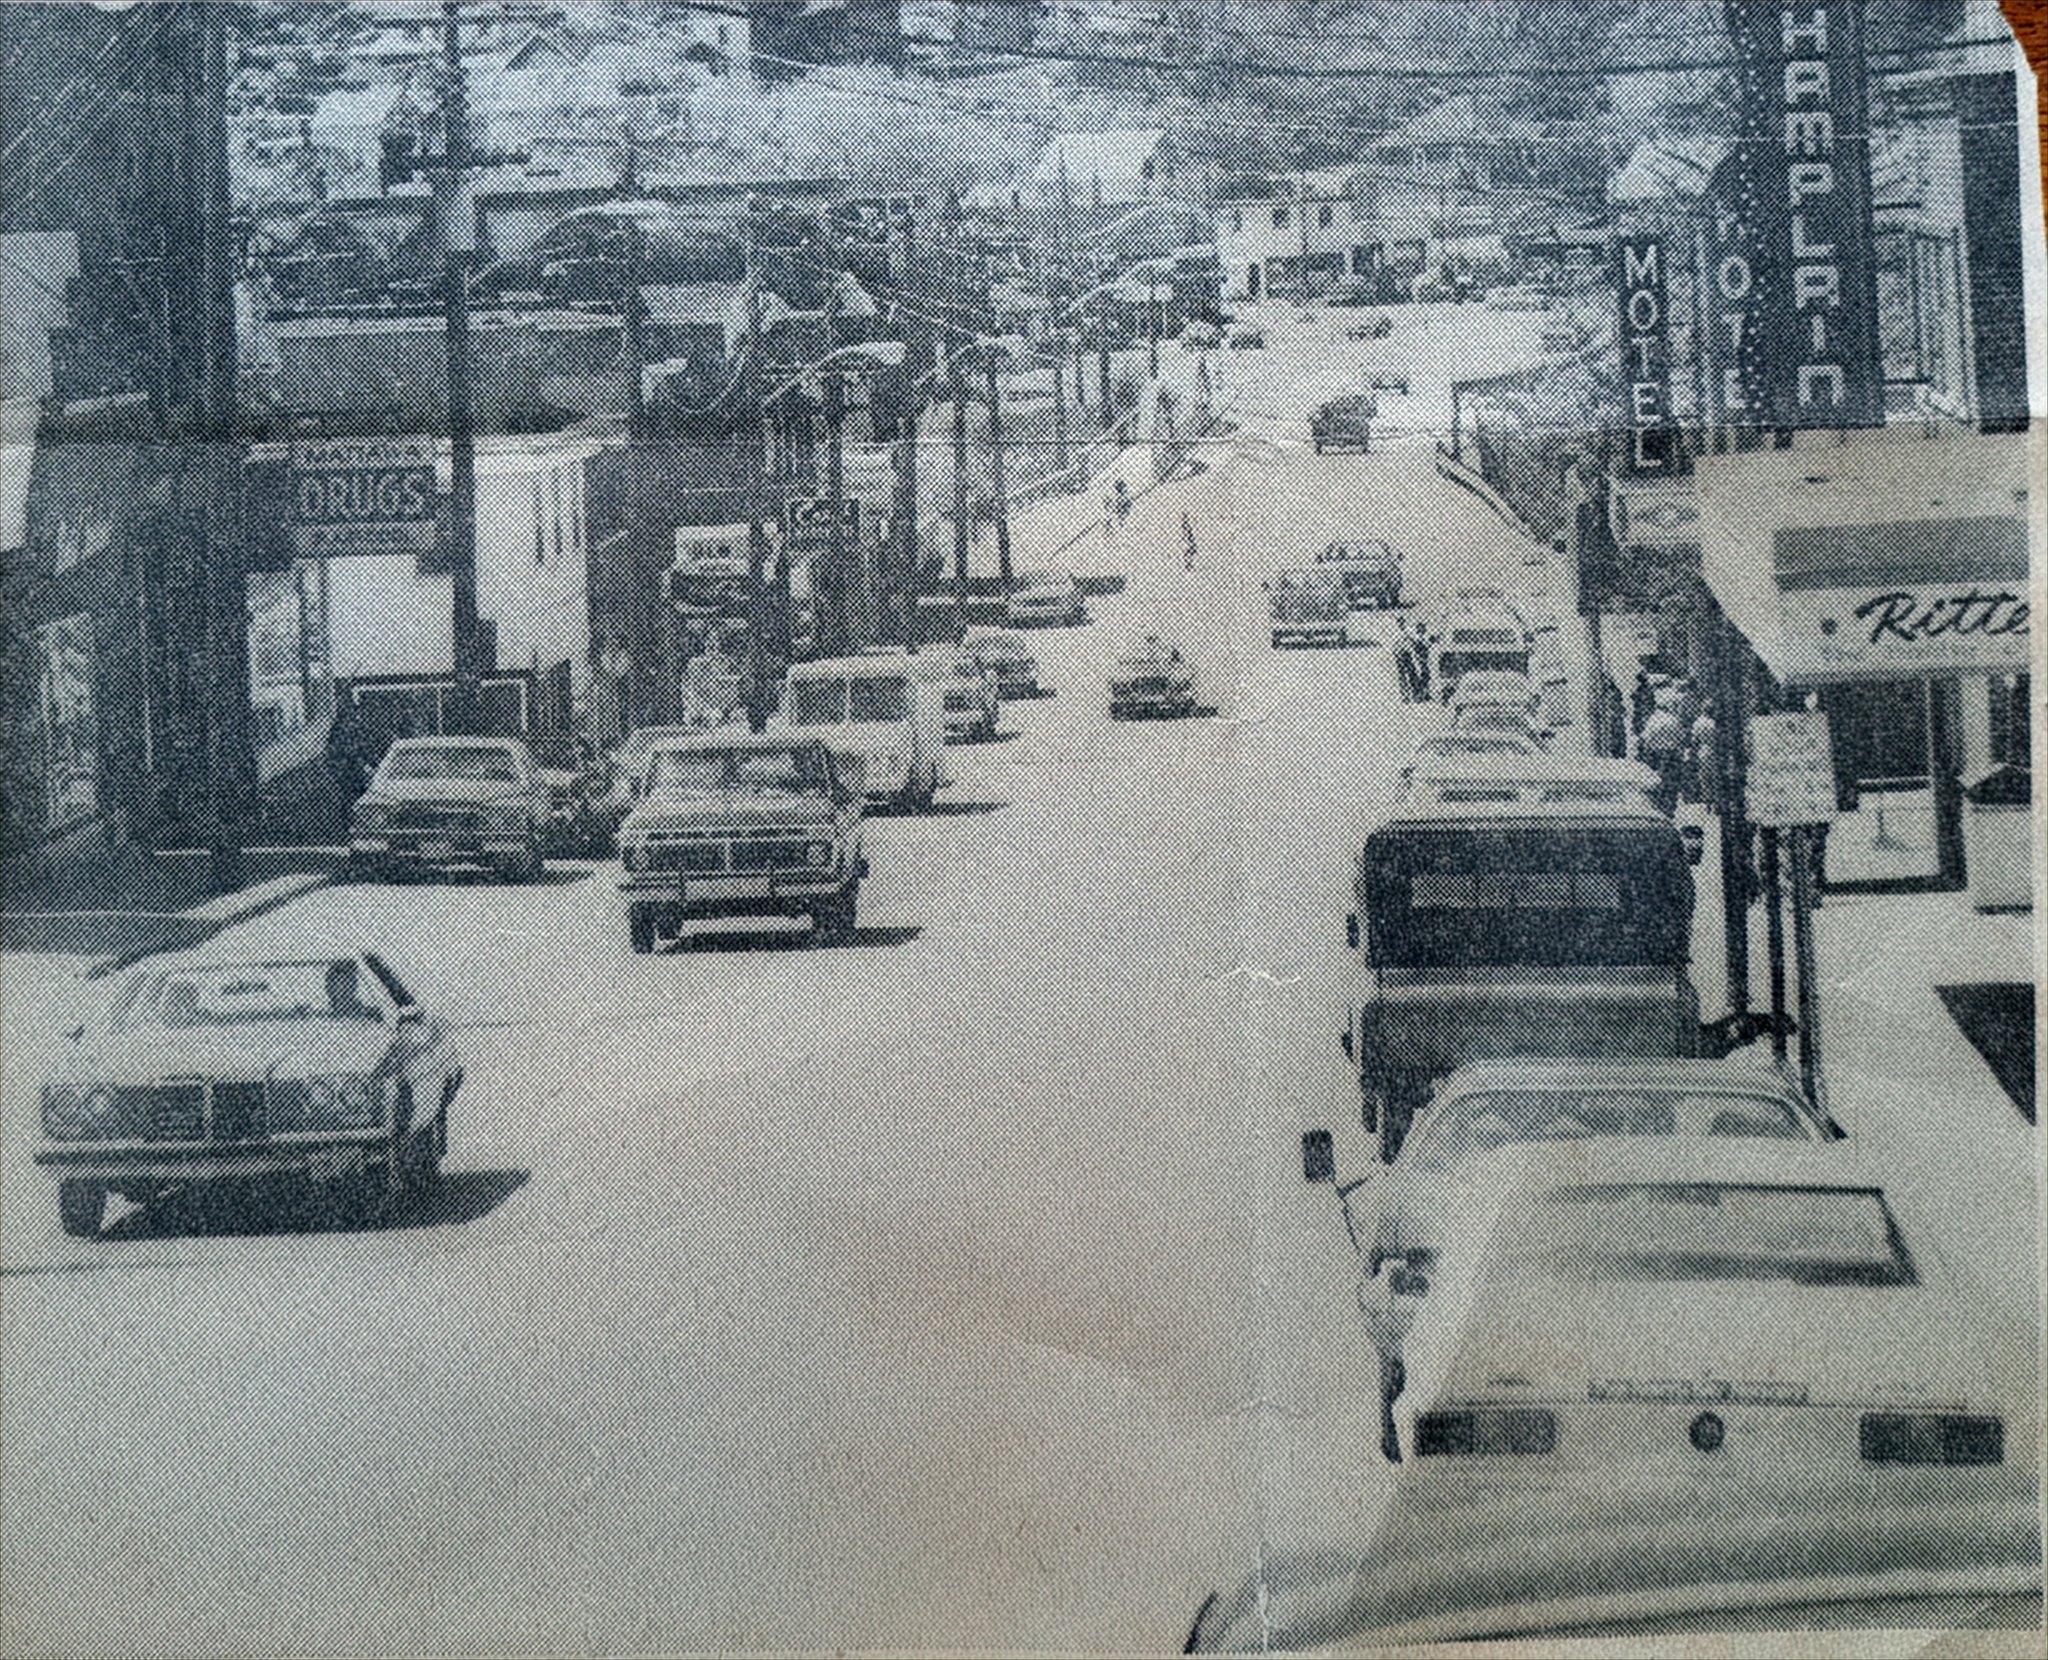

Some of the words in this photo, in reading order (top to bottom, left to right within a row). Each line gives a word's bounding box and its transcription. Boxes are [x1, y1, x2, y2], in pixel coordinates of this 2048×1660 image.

[1624, 243, 1663, 468] MOTEL
[300, 472, 426, 519] DRUGS
[1854, 588, 2030, 644] Ritte
